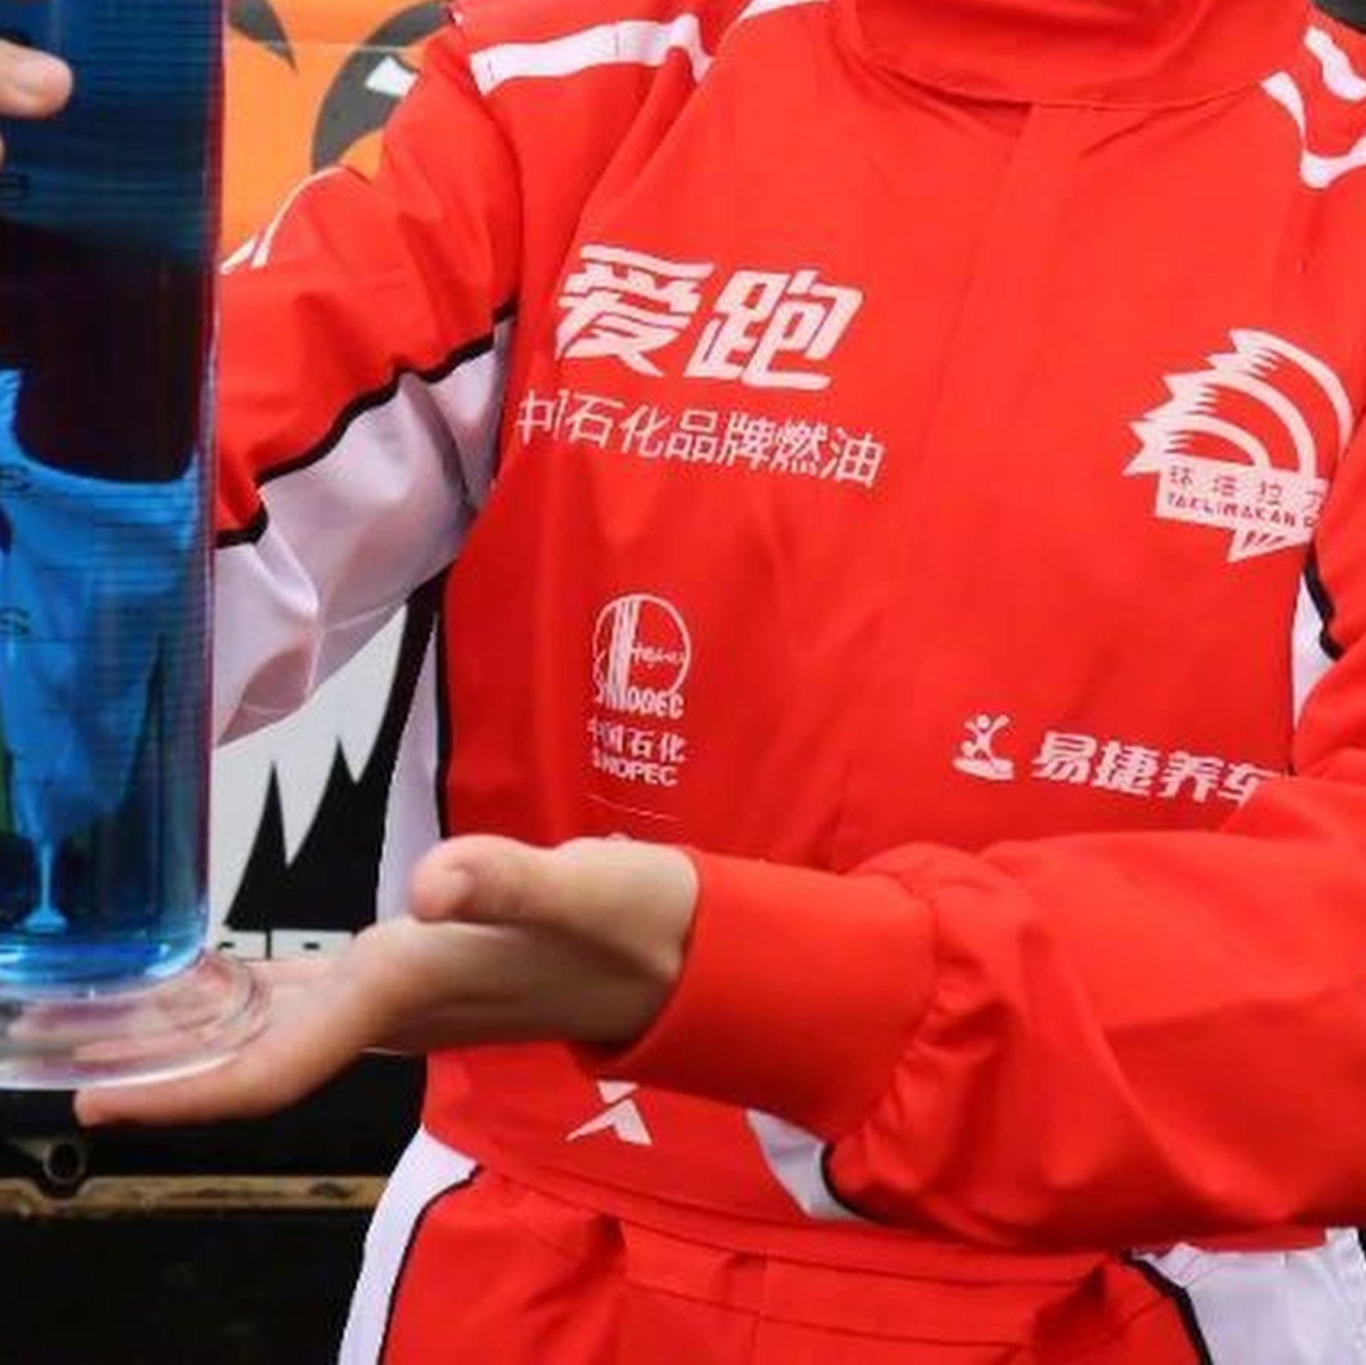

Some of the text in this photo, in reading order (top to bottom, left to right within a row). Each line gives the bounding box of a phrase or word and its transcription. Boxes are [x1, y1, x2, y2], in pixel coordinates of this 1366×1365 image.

[555, 244, 863, 392] 爱跑
[515, 390, 884, 487] 中石化品牌燃油
[1166, 491, 1296, 529] TAKLIMAKAN
[592, 745, 678, 787] SNOPEC
